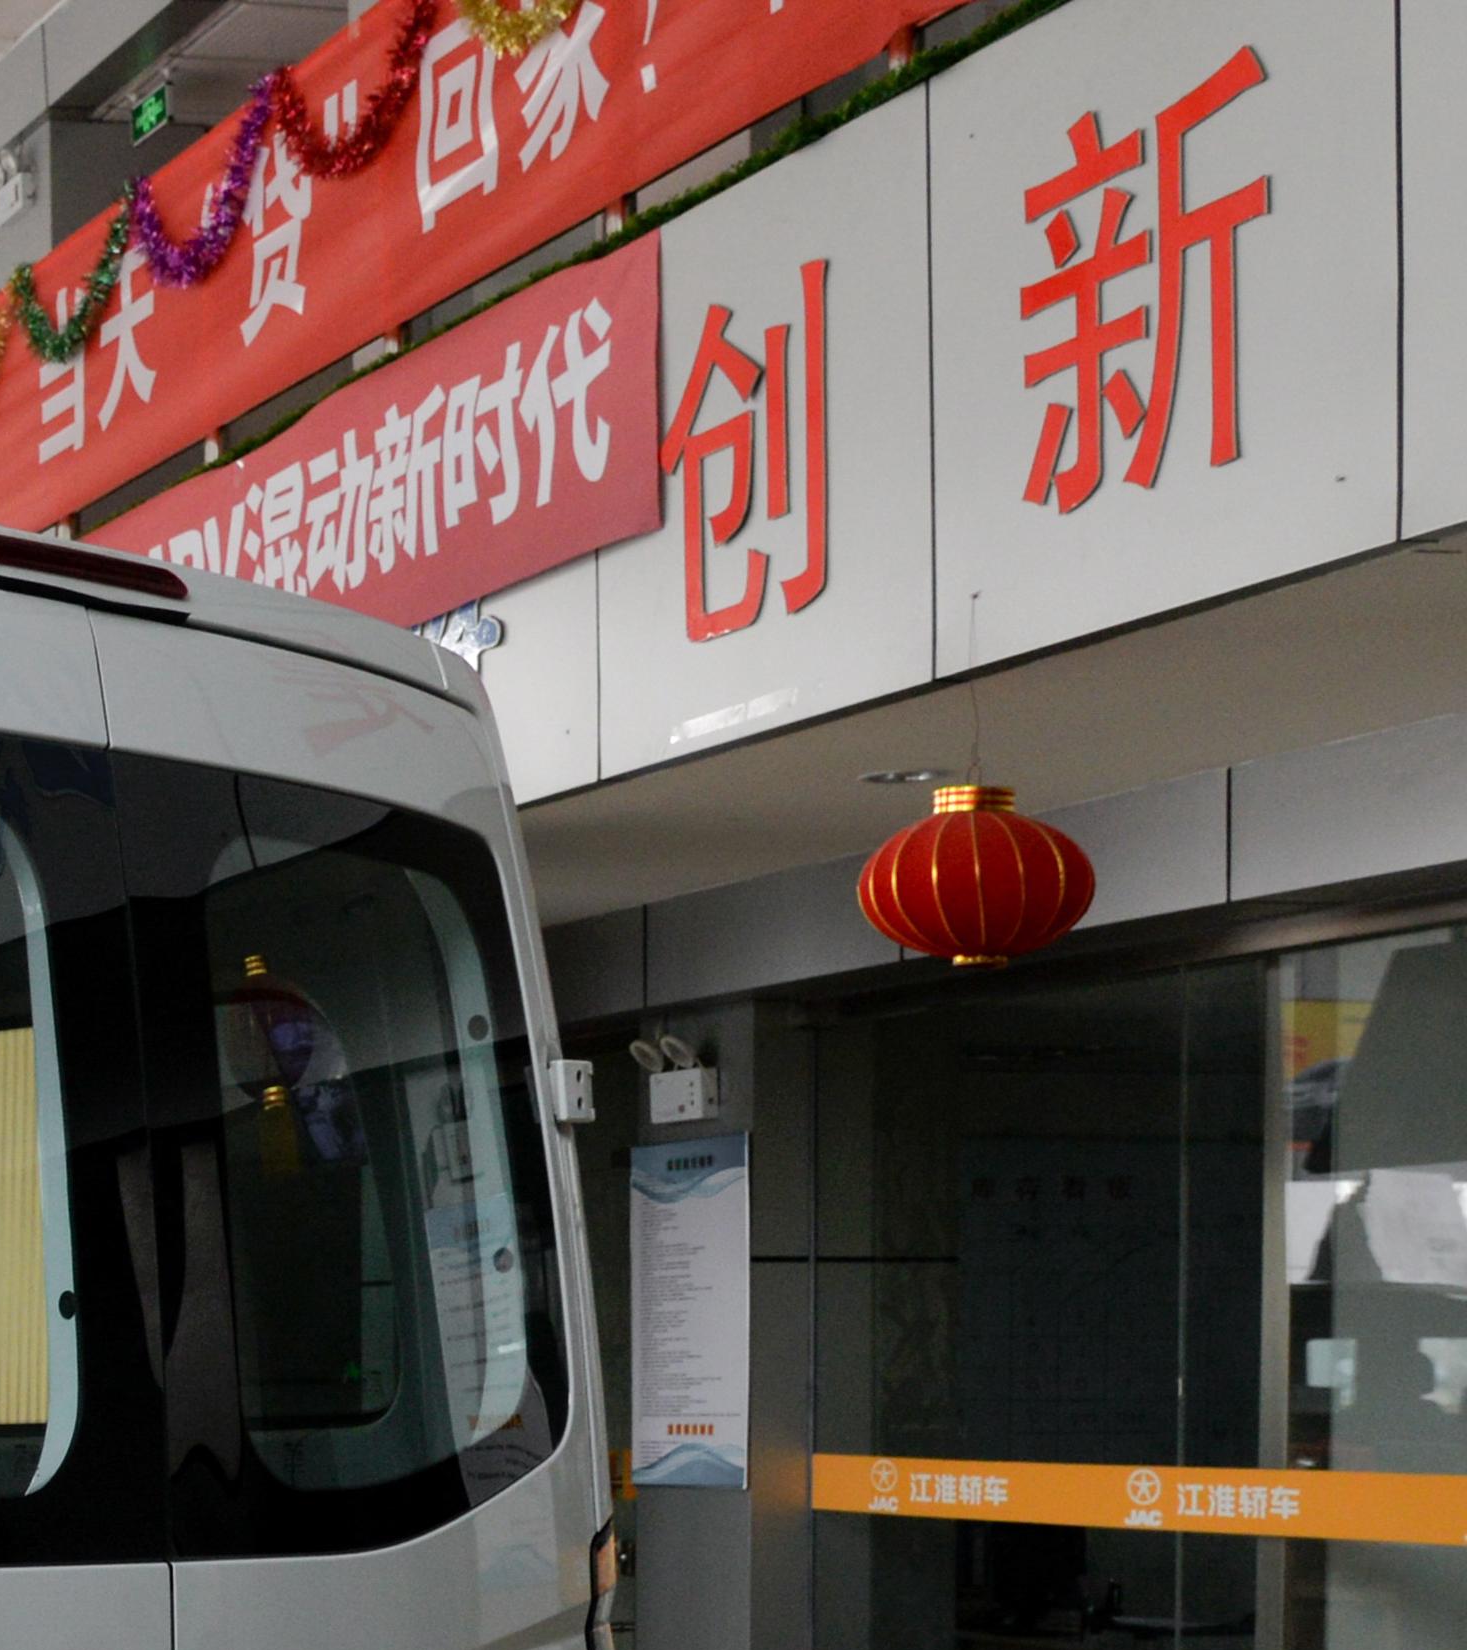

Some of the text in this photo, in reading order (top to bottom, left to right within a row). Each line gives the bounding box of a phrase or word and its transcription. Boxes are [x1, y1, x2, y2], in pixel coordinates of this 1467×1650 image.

[660, 46, 1271, 643] 创新
[869, 1473, 1009, 1513] JAC 江淮轿车
[1124, 1482, 1301, 1527] JAC 江淮轿车
